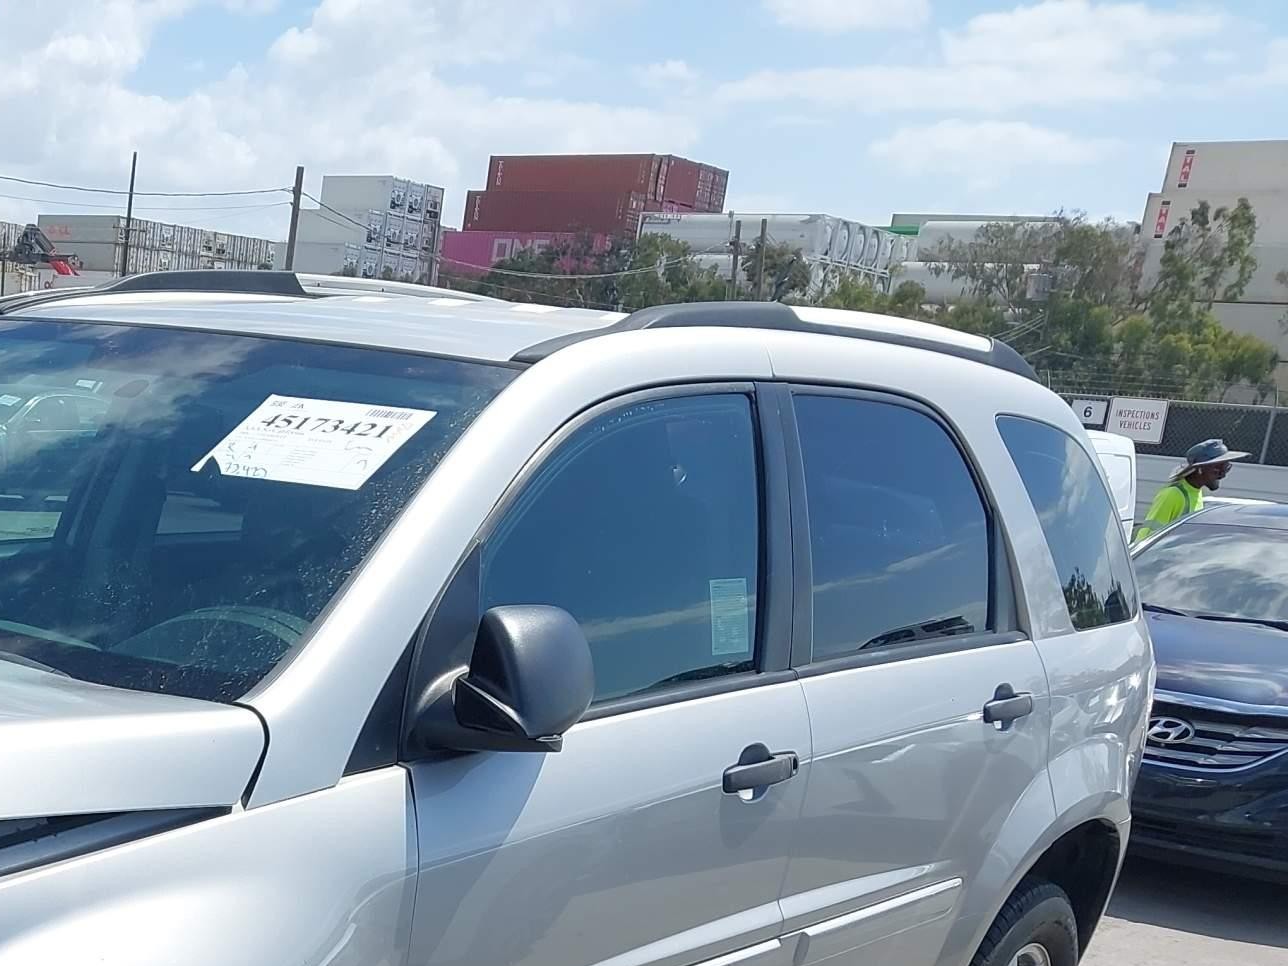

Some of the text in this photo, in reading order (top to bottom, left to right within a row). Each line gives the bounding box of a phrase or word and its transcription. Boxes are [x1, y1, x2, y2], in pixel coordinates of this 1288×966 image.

[1083, 406, 1093, 418] 6
[1115, 408, 1160, 420] INSPECTIONS
[261, 413, 394, 438] 45173421
[1119, 420, 1152, 431] VEHICLES
